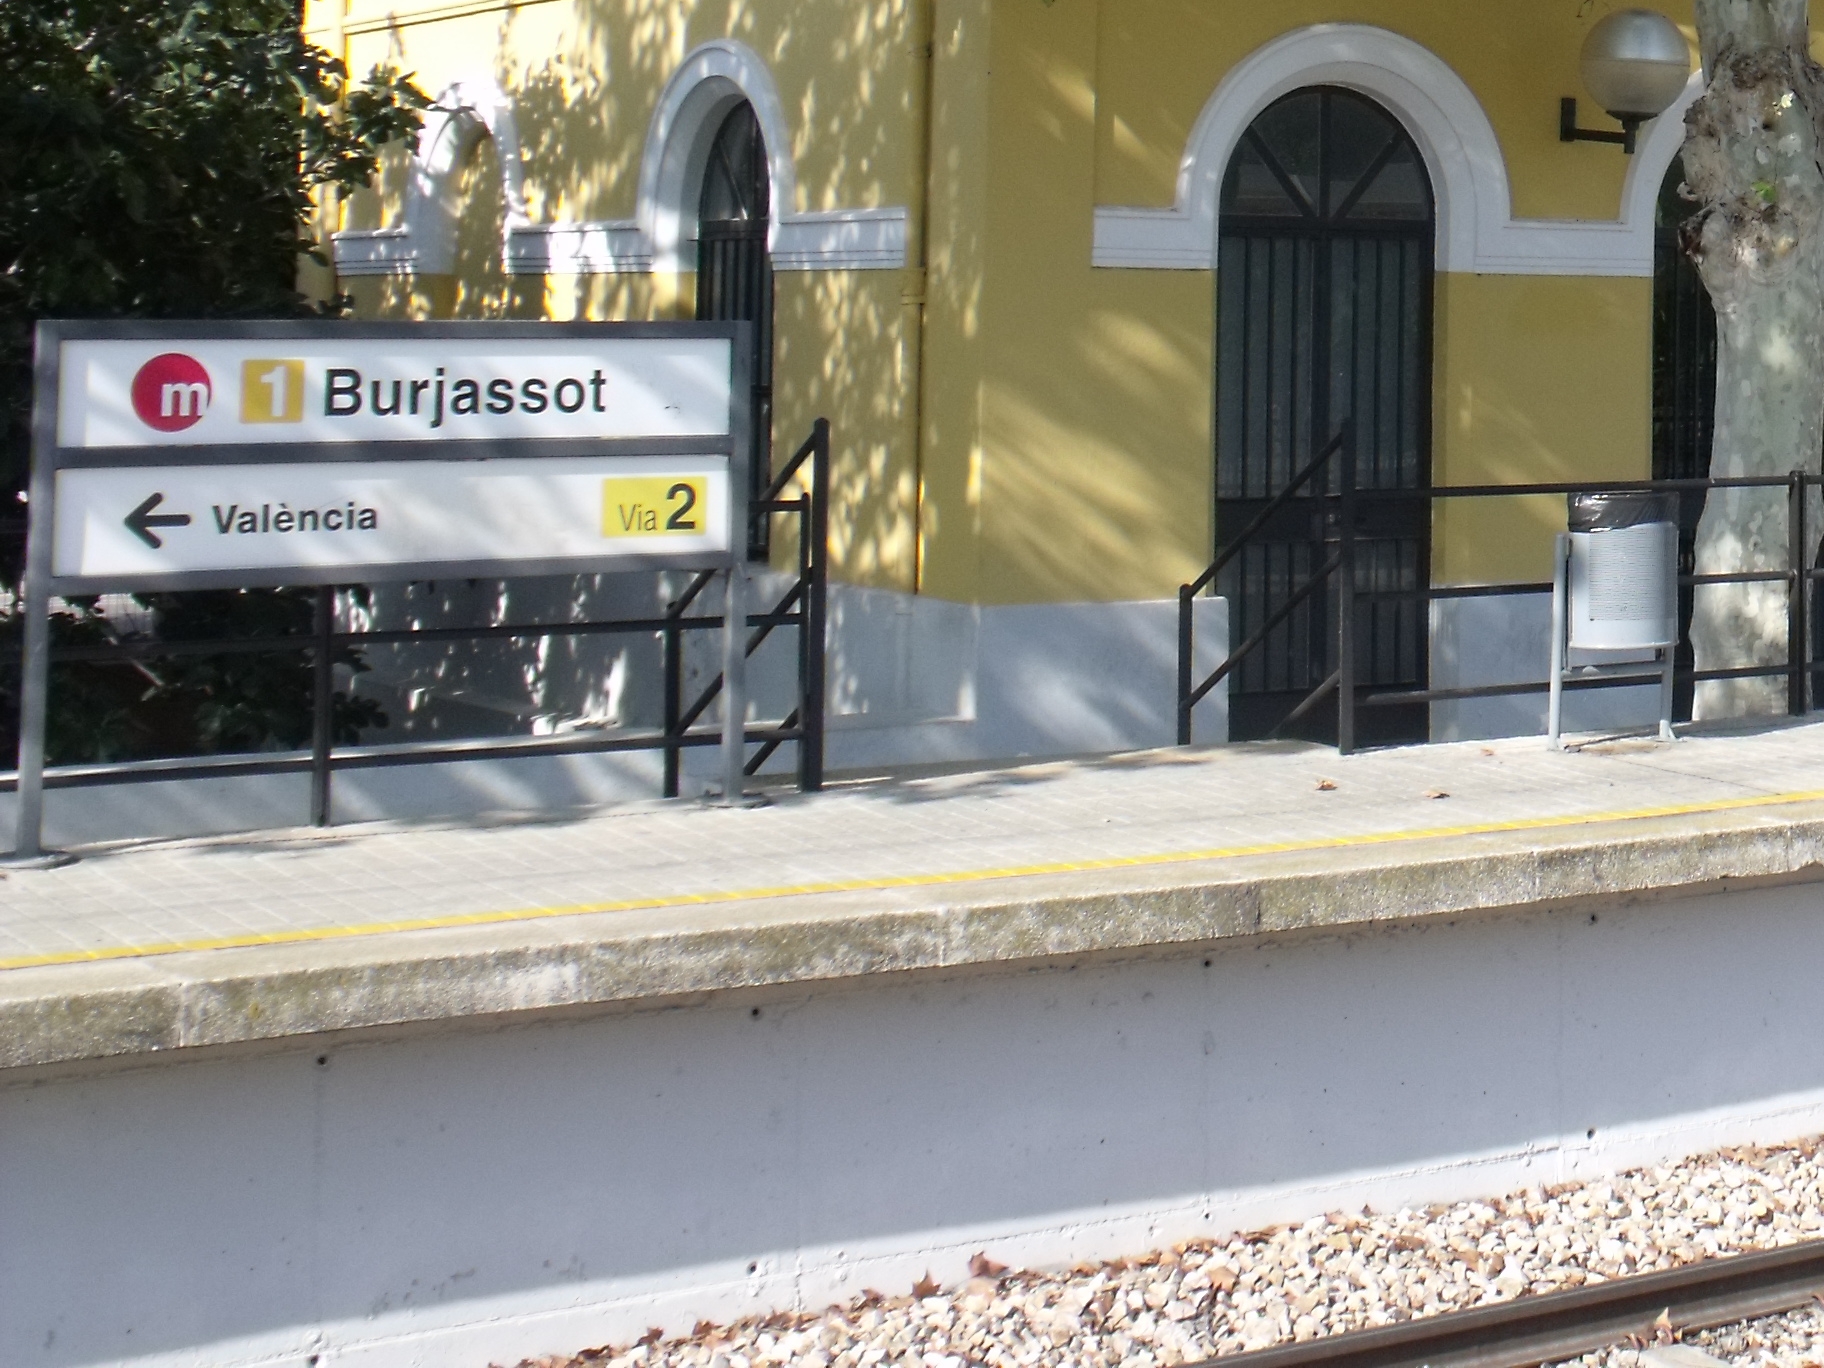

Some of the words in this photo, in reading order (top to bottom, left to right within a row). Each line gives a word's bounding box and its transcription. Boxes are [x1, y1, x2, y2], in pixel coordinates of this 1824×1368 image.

[159, 379, 208, 418] m
[259, 367, 289, 418] 1
[323, 367, 608, 428] Burjassot
[212, 500, 379, 535] València
[665, 482, 697, 531] 2
